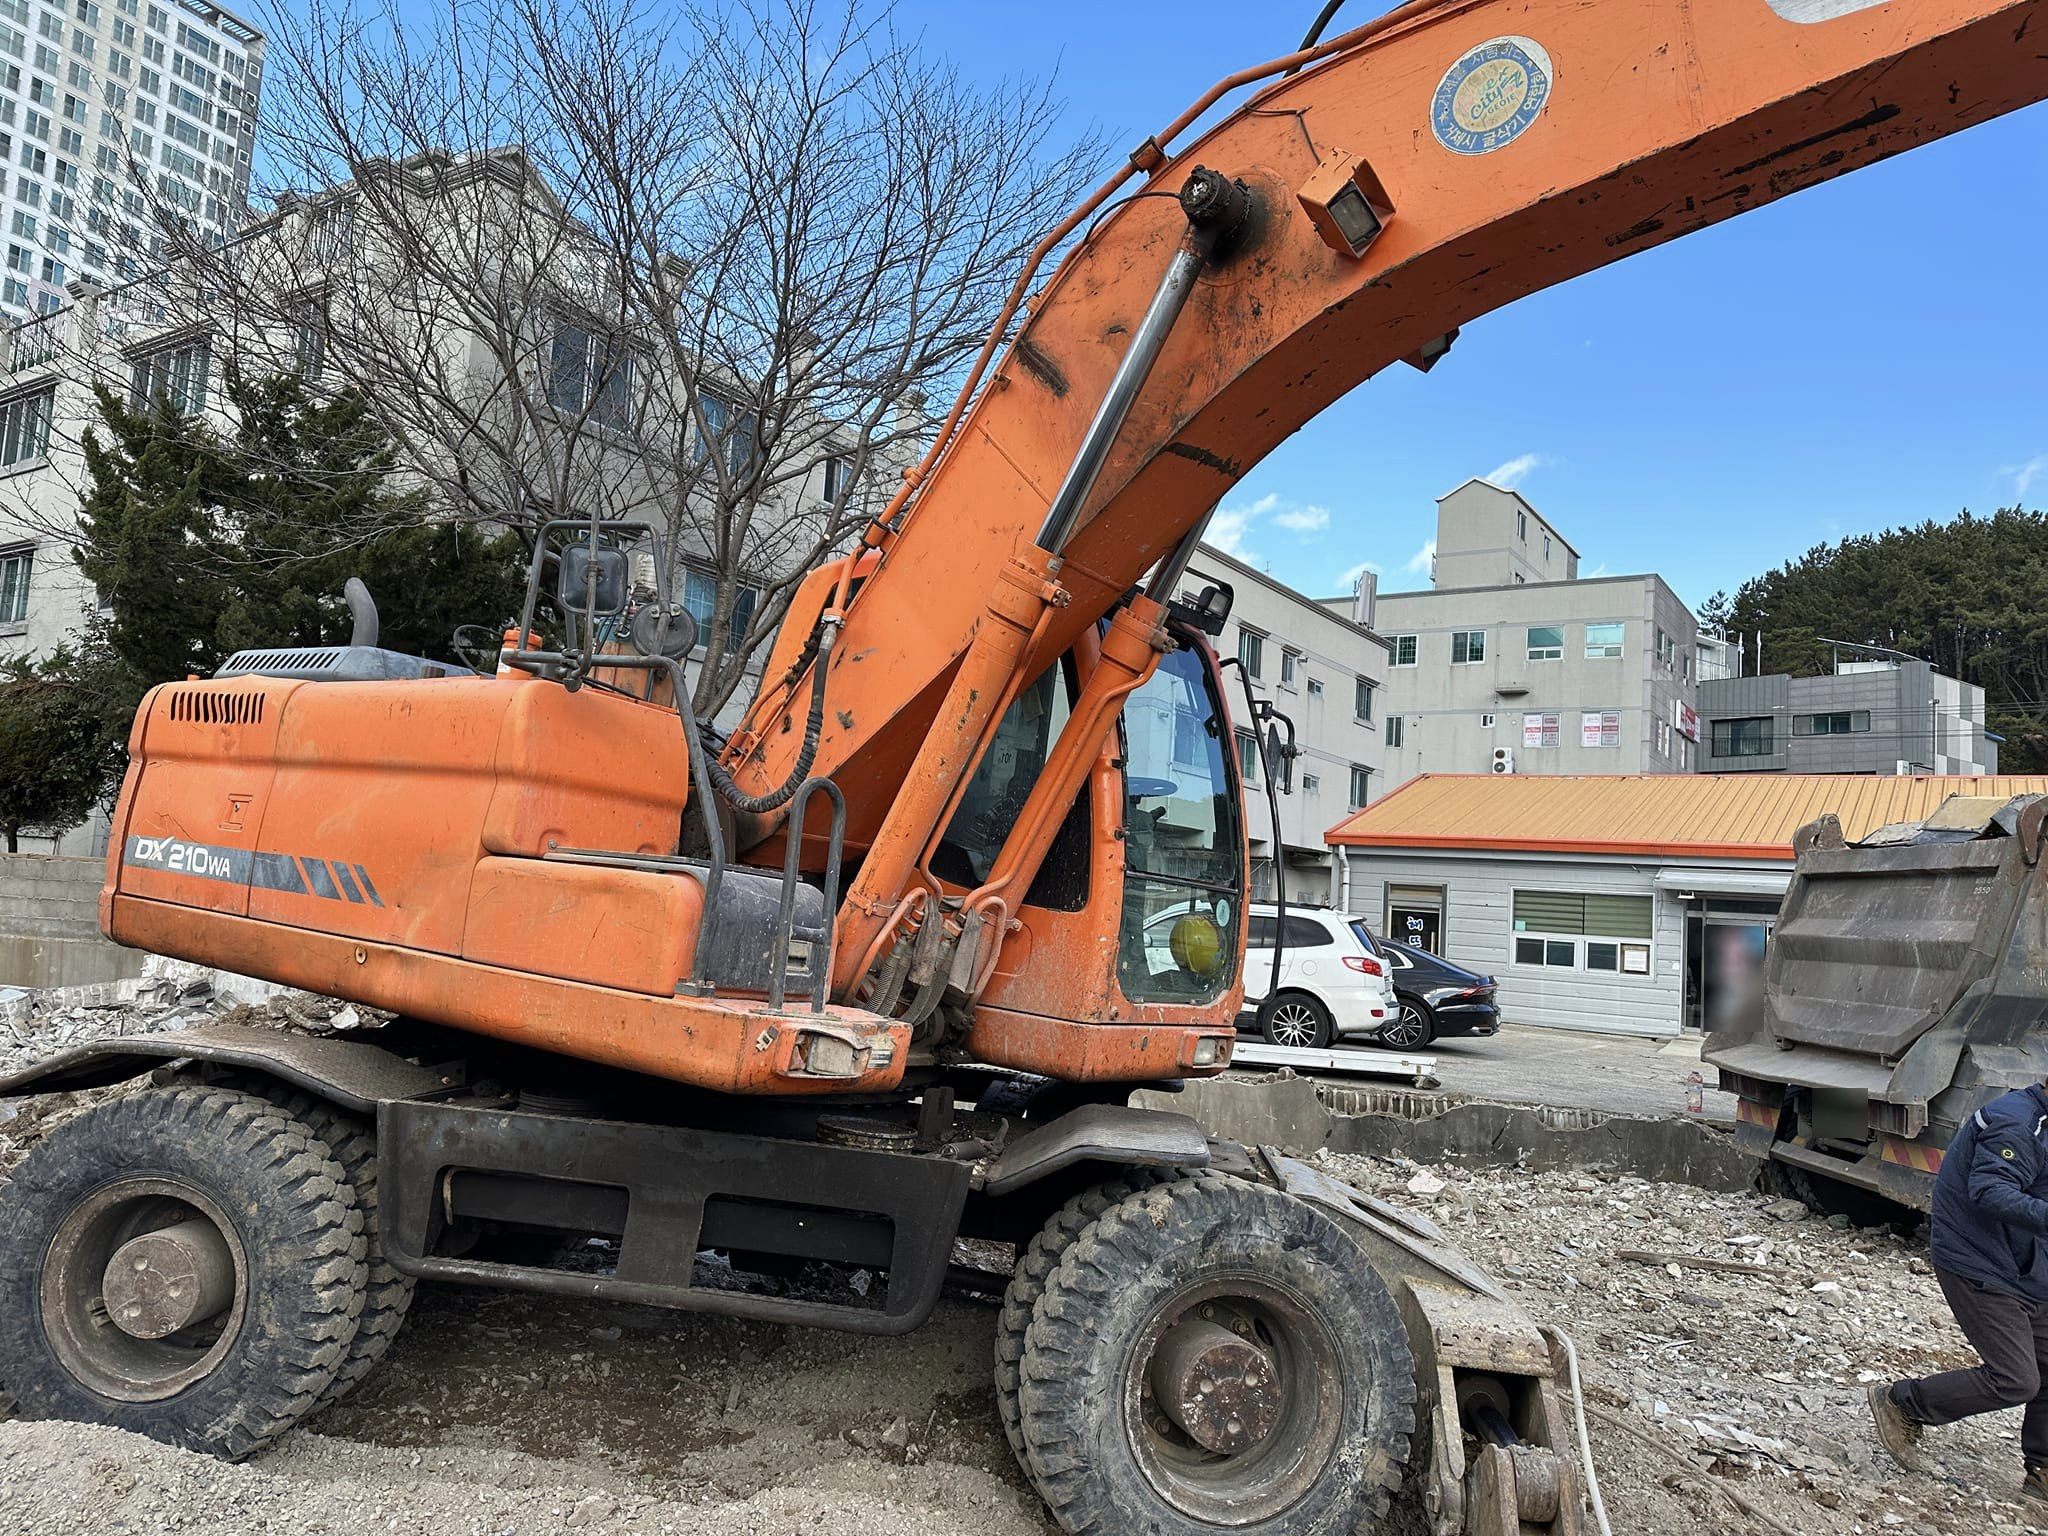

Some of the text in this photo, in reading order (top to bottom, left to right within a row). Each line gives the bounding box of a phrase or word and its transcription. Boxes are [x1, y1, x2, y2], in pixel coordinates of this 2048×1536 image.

[1444, 122, 1478, 149] 거제시
[1482, 114, 1526, 148] 굴삭기
[134, 835, 175, 862] DX
